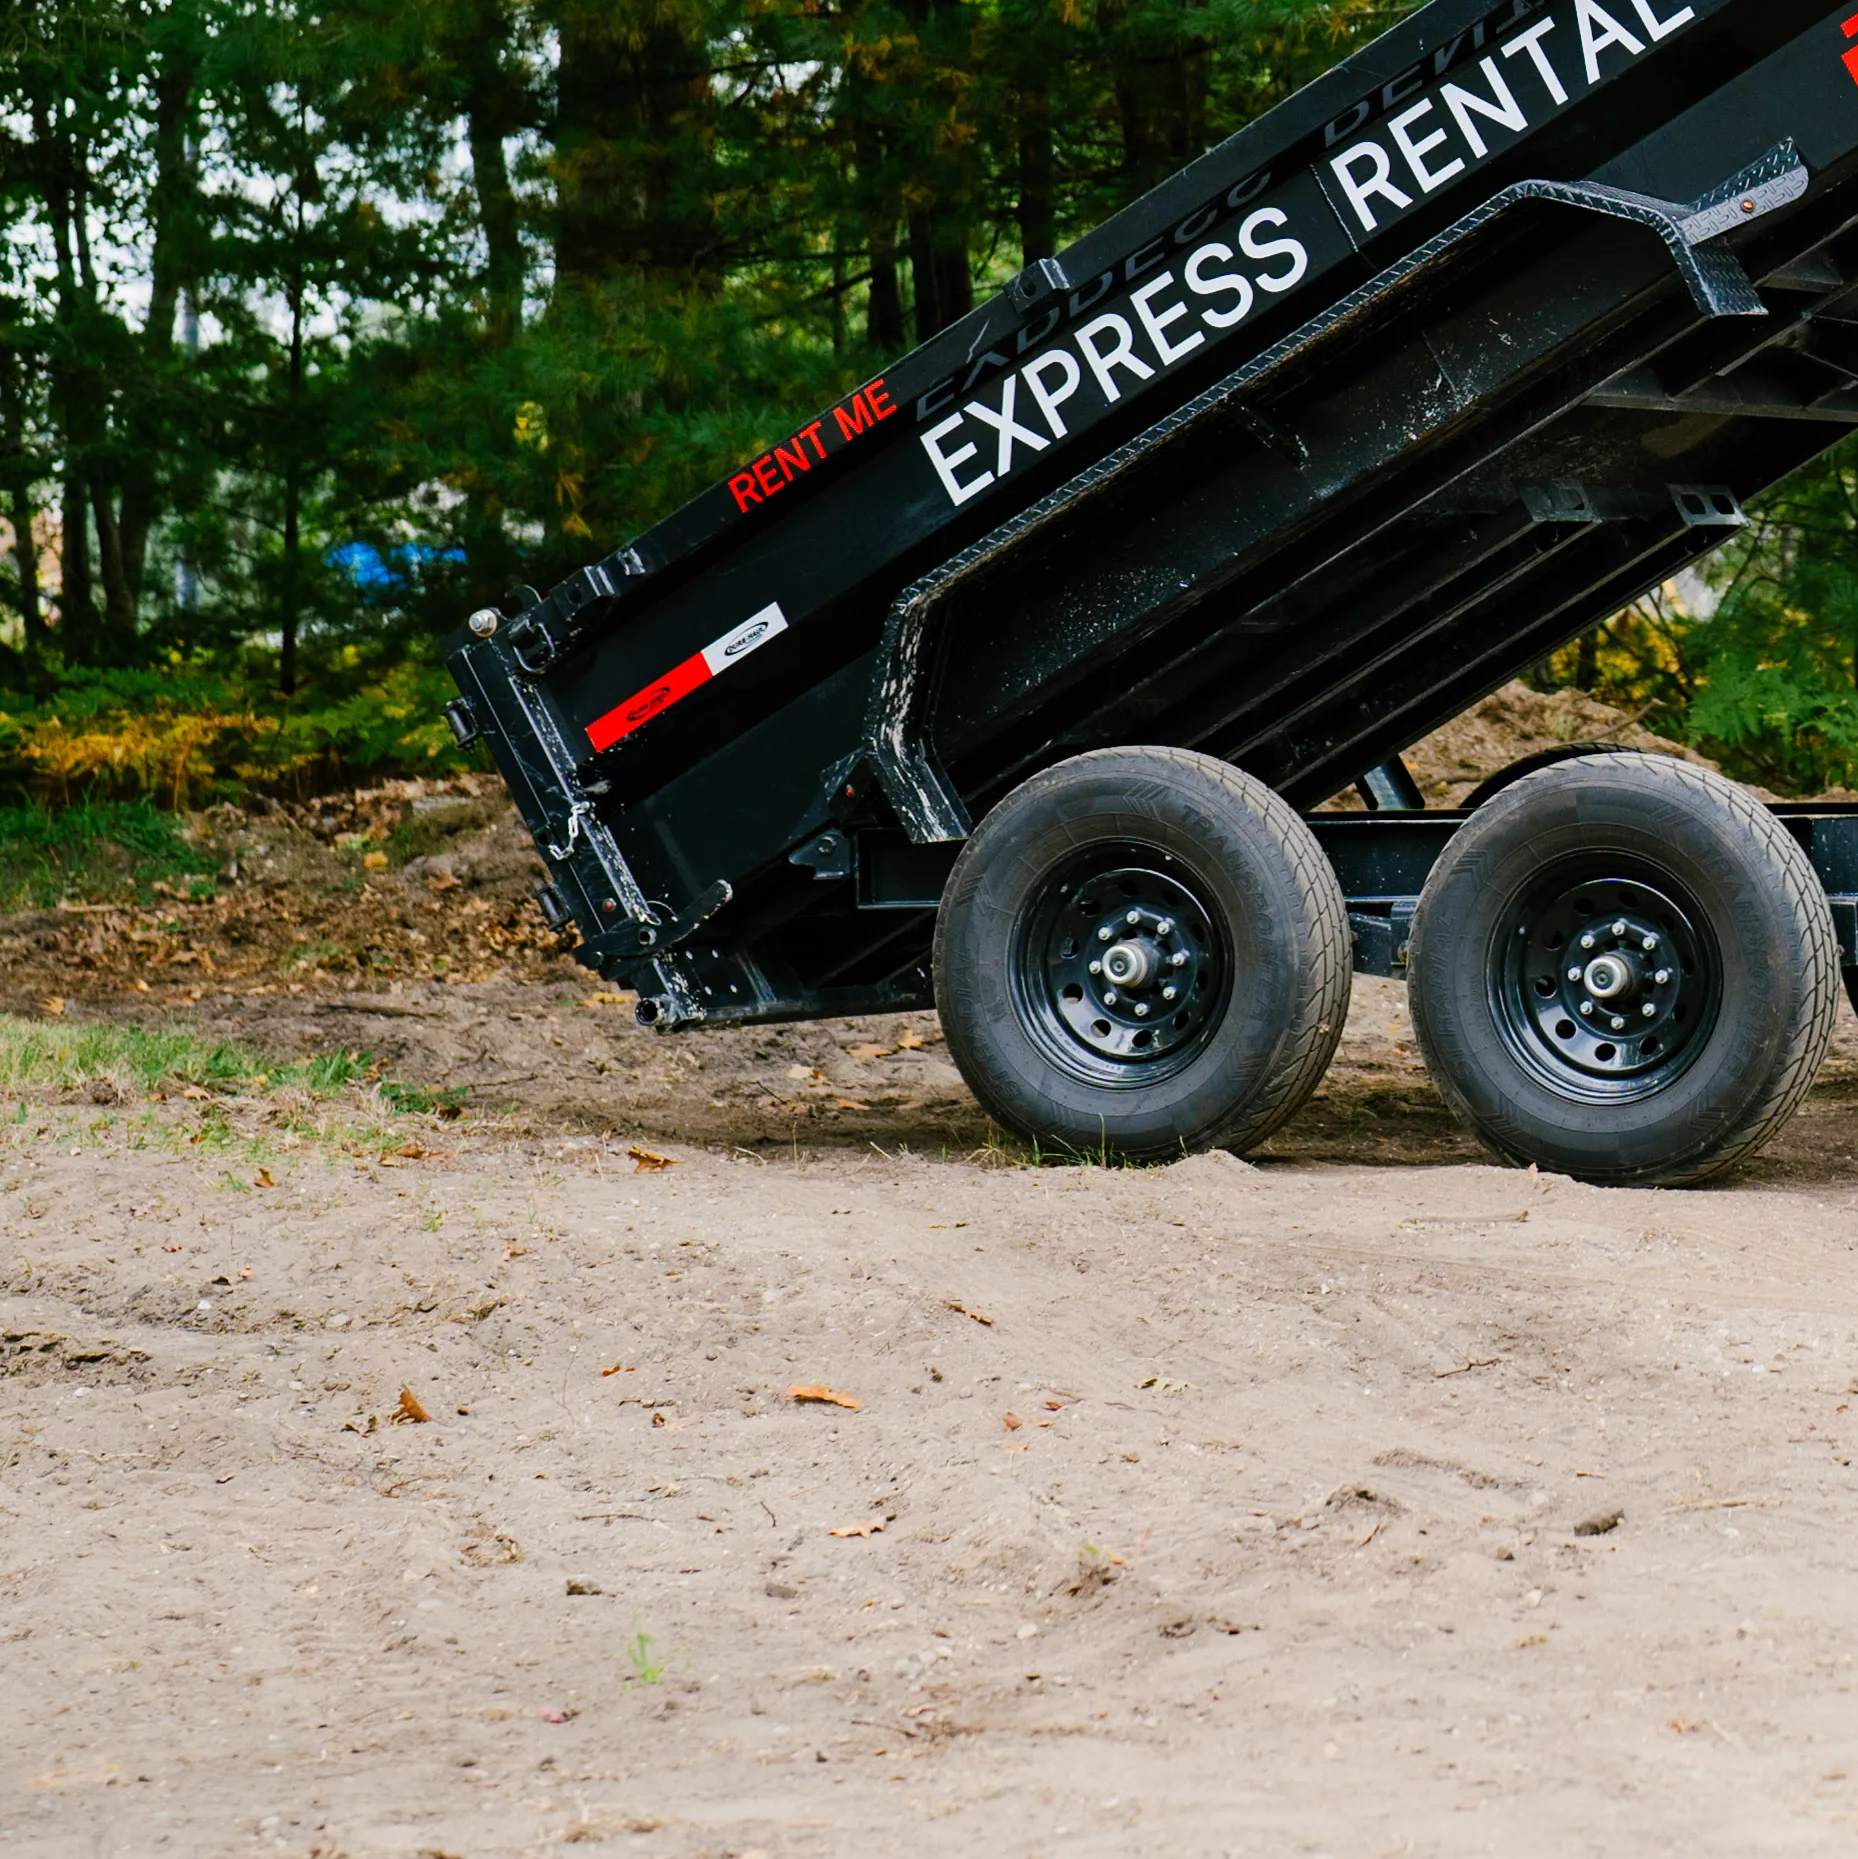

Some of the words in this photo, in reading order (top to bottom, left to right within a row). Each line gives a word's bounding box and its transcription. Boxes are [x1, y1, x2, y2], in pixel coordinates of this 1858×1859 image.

[727, 420, 828, 513] RENT
[832, 378, 897, 441] ME
[920, 207, 1308, 507] EXPRESS
